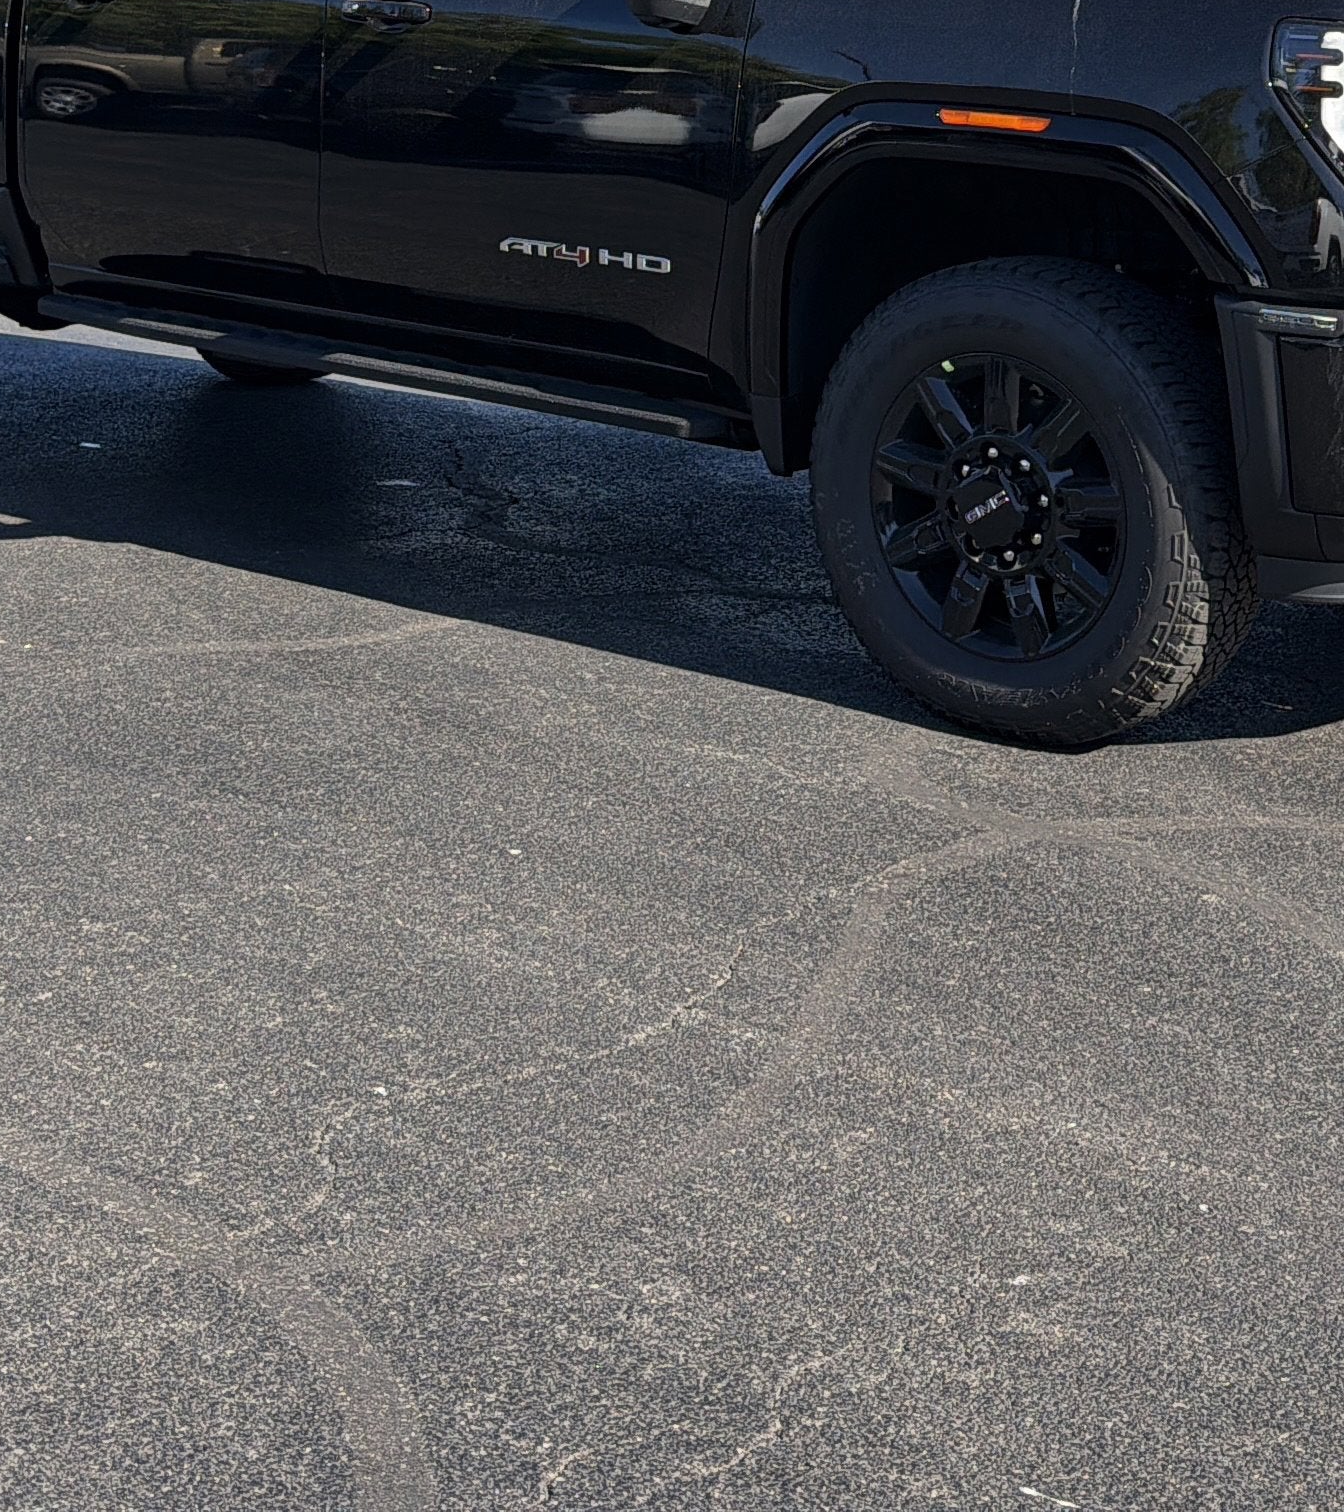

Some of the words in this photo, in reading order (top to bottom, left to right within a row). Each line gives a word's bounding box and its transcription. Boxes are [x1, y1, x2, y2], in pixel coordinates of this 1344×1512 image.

[499, 237, 589, 267] AT4
[598, 248, 671, 273] HD
[965, 490, 1009, 524] GMC
